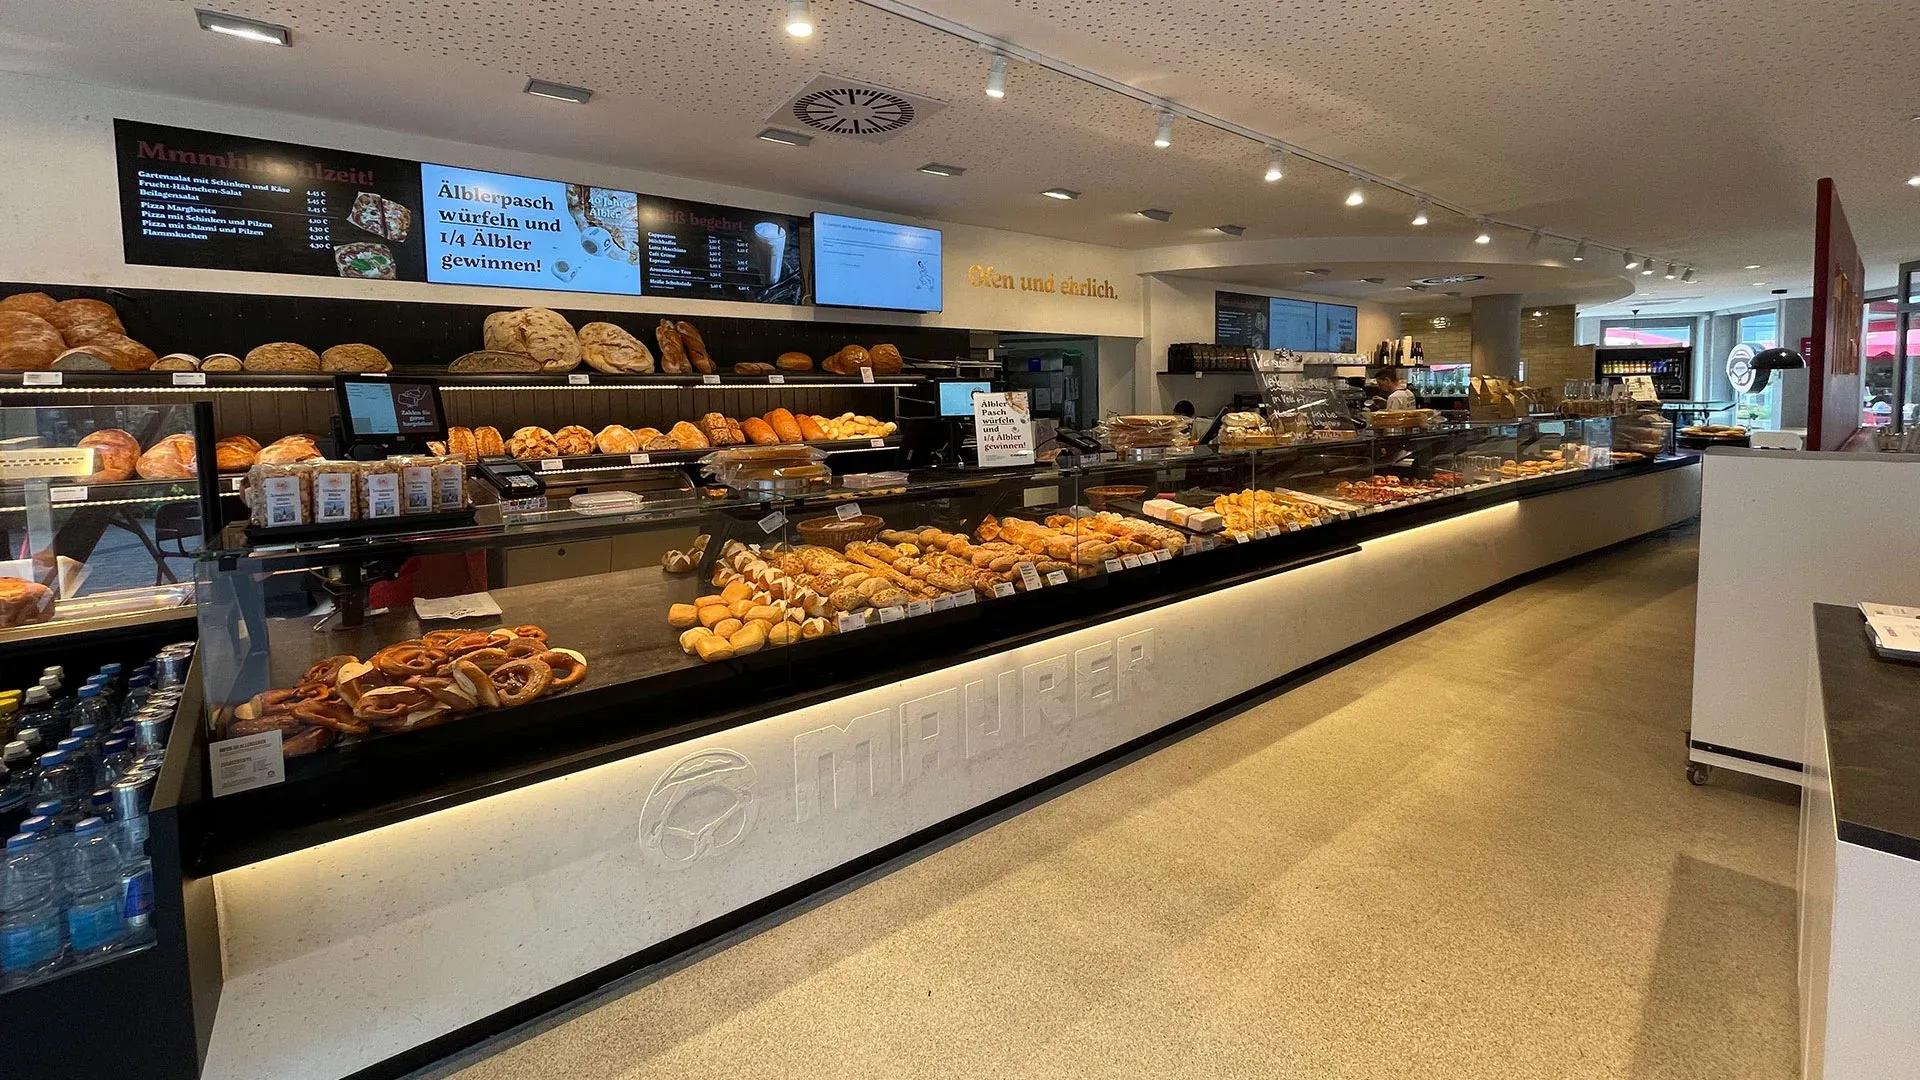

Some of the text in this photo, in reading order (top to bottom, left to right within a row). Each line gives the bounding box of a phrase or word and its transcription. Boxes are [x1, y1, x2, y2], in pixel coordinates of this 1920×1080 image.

[138, 170, 291, 193] Gartensalat mit Schinken und Käse
[139, 179, 242, 196] Frucht-Hähnchen-Salat
[139, 189, 200, 201] Beilagensalat
[437, 179, 555, 212] Älblerpasch
[140, 201, 217, 215] Pizza Margherita
[141, 210, 166, 219] Pizza
[167, 213, 184, 221] mit
[186, 215, 227, 224] Schinken
[247, 220, 273, 229] Pilzen
[142, 219, 167, 228] Pizza
[186, 223, 217, 232] Salami
[219, 226, 236, 234] und
[238, 227, 264, 236] Pilzen
[438, 208, 562, 233] würfeln und
[142, 228, 208, 240] Flammkuchen
[440, 229, 532, 251] 1/4 Älbler
[648, 231, 676, 240] Cappuccino
[441, 253, 542, 273] gewinnen!
[968, 263, 1118, 300] Ofen und ehrlich.
[983, 416, 1015, 424] würfeln
[984, 442, 1026, 452] gewinnen!
[794, 628, 1157, 822] MAURER
